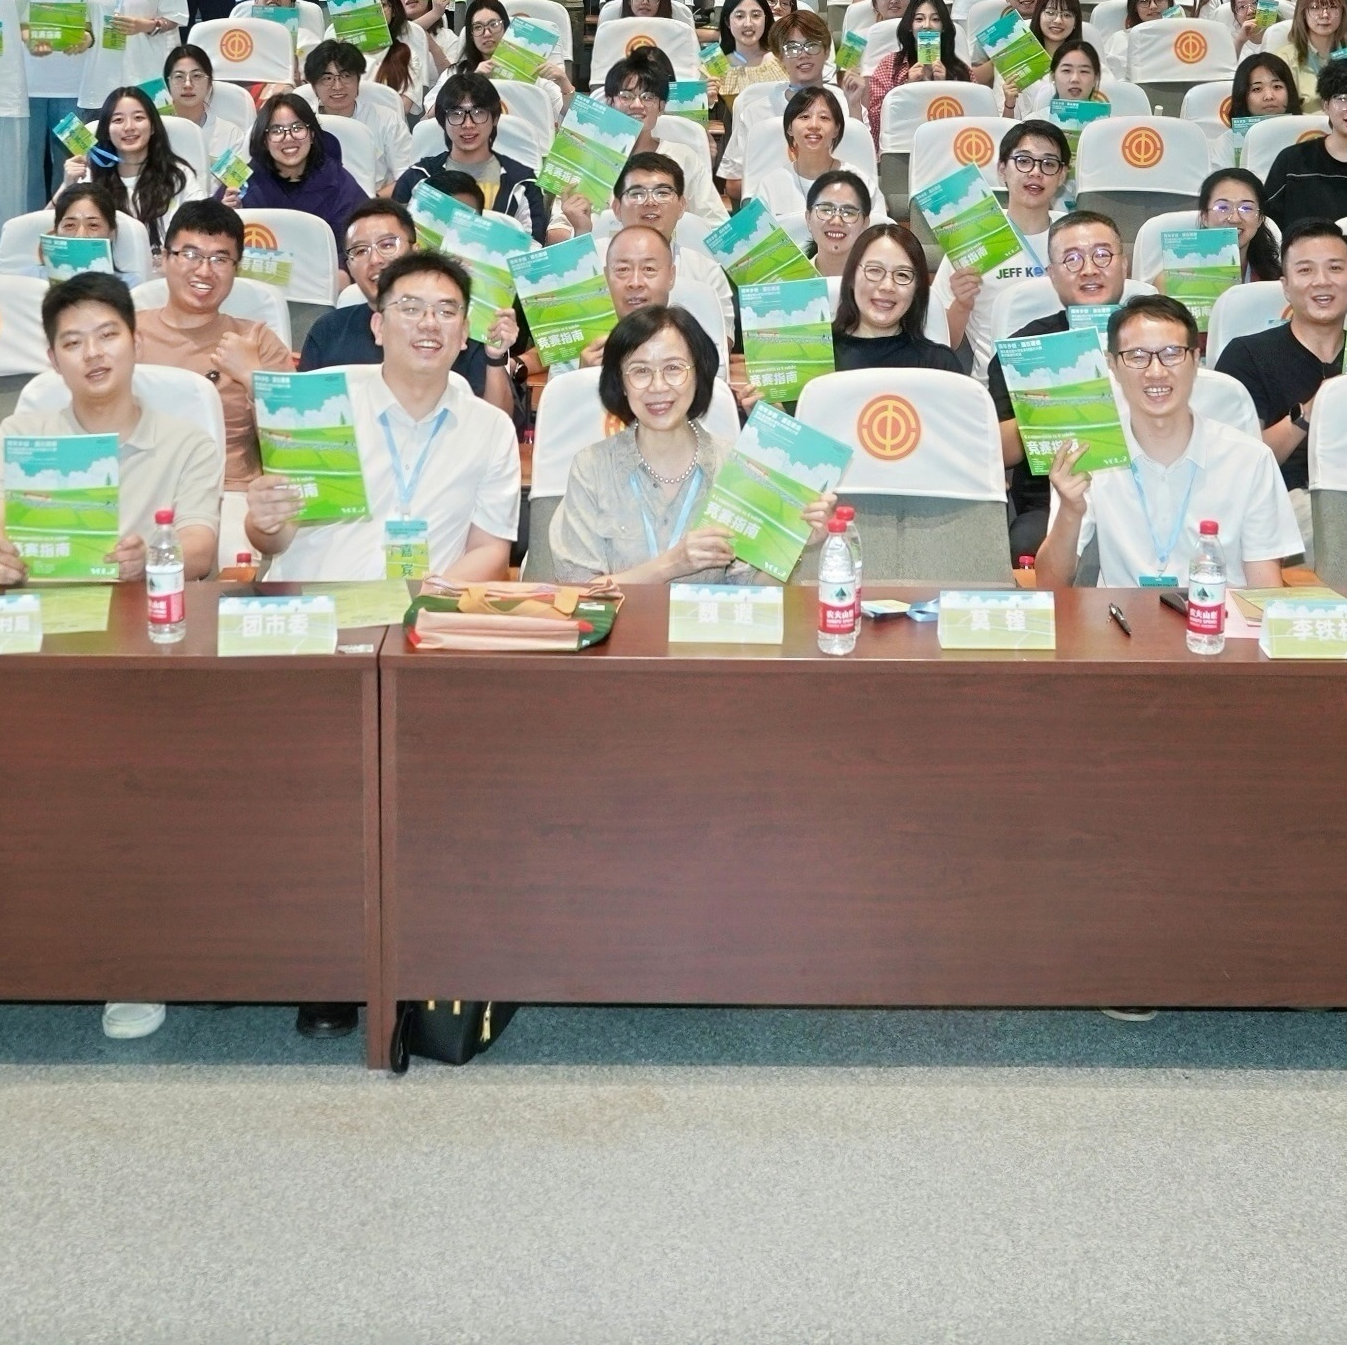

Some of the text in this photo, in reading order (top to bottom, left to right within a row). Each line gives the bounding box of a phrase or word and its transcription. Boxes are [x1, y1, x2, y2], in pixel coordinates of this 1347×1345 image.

[996, 267, 1023, 280] JEFF
[536, 329, 585, 351] 竞赛指南
[749, 371, 798, 387] 竞赛指南
[702, 500, 762, 540] 竞赛指南
[400, 543, 414, 577] 嘉宾
[242, 614, 309, 638] 团市委
[970, 610, 991, 632] 莫
